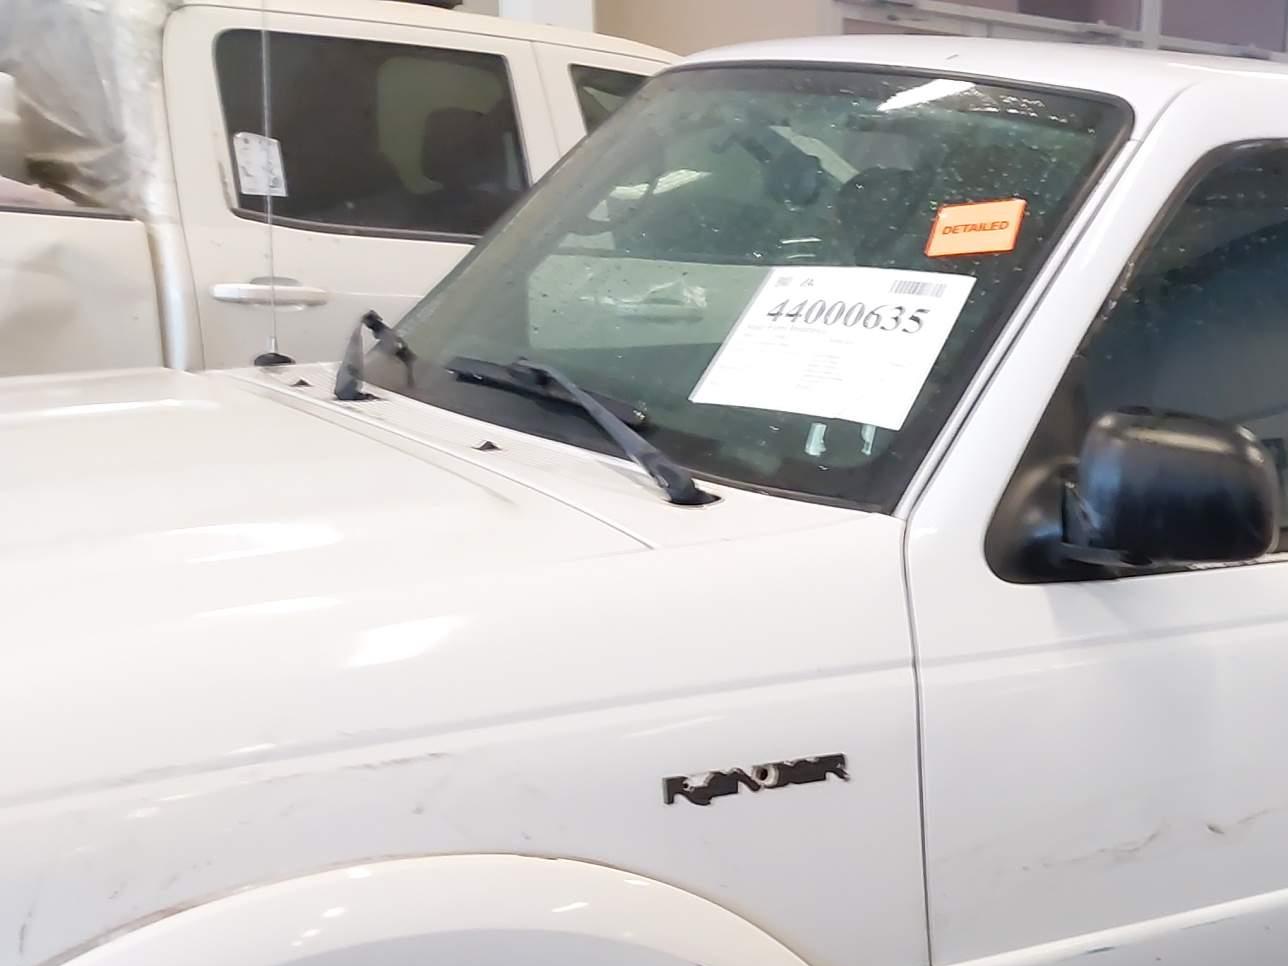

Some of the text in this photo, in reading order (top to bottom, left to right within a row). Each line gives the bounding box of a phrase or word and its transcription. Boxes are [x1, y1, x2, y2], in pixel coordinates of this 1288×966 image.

[942, 221, 1009, 235] DETAILED
[767, 299, 931, 334] 44000635
[662, 753, 849, 806] RNR
